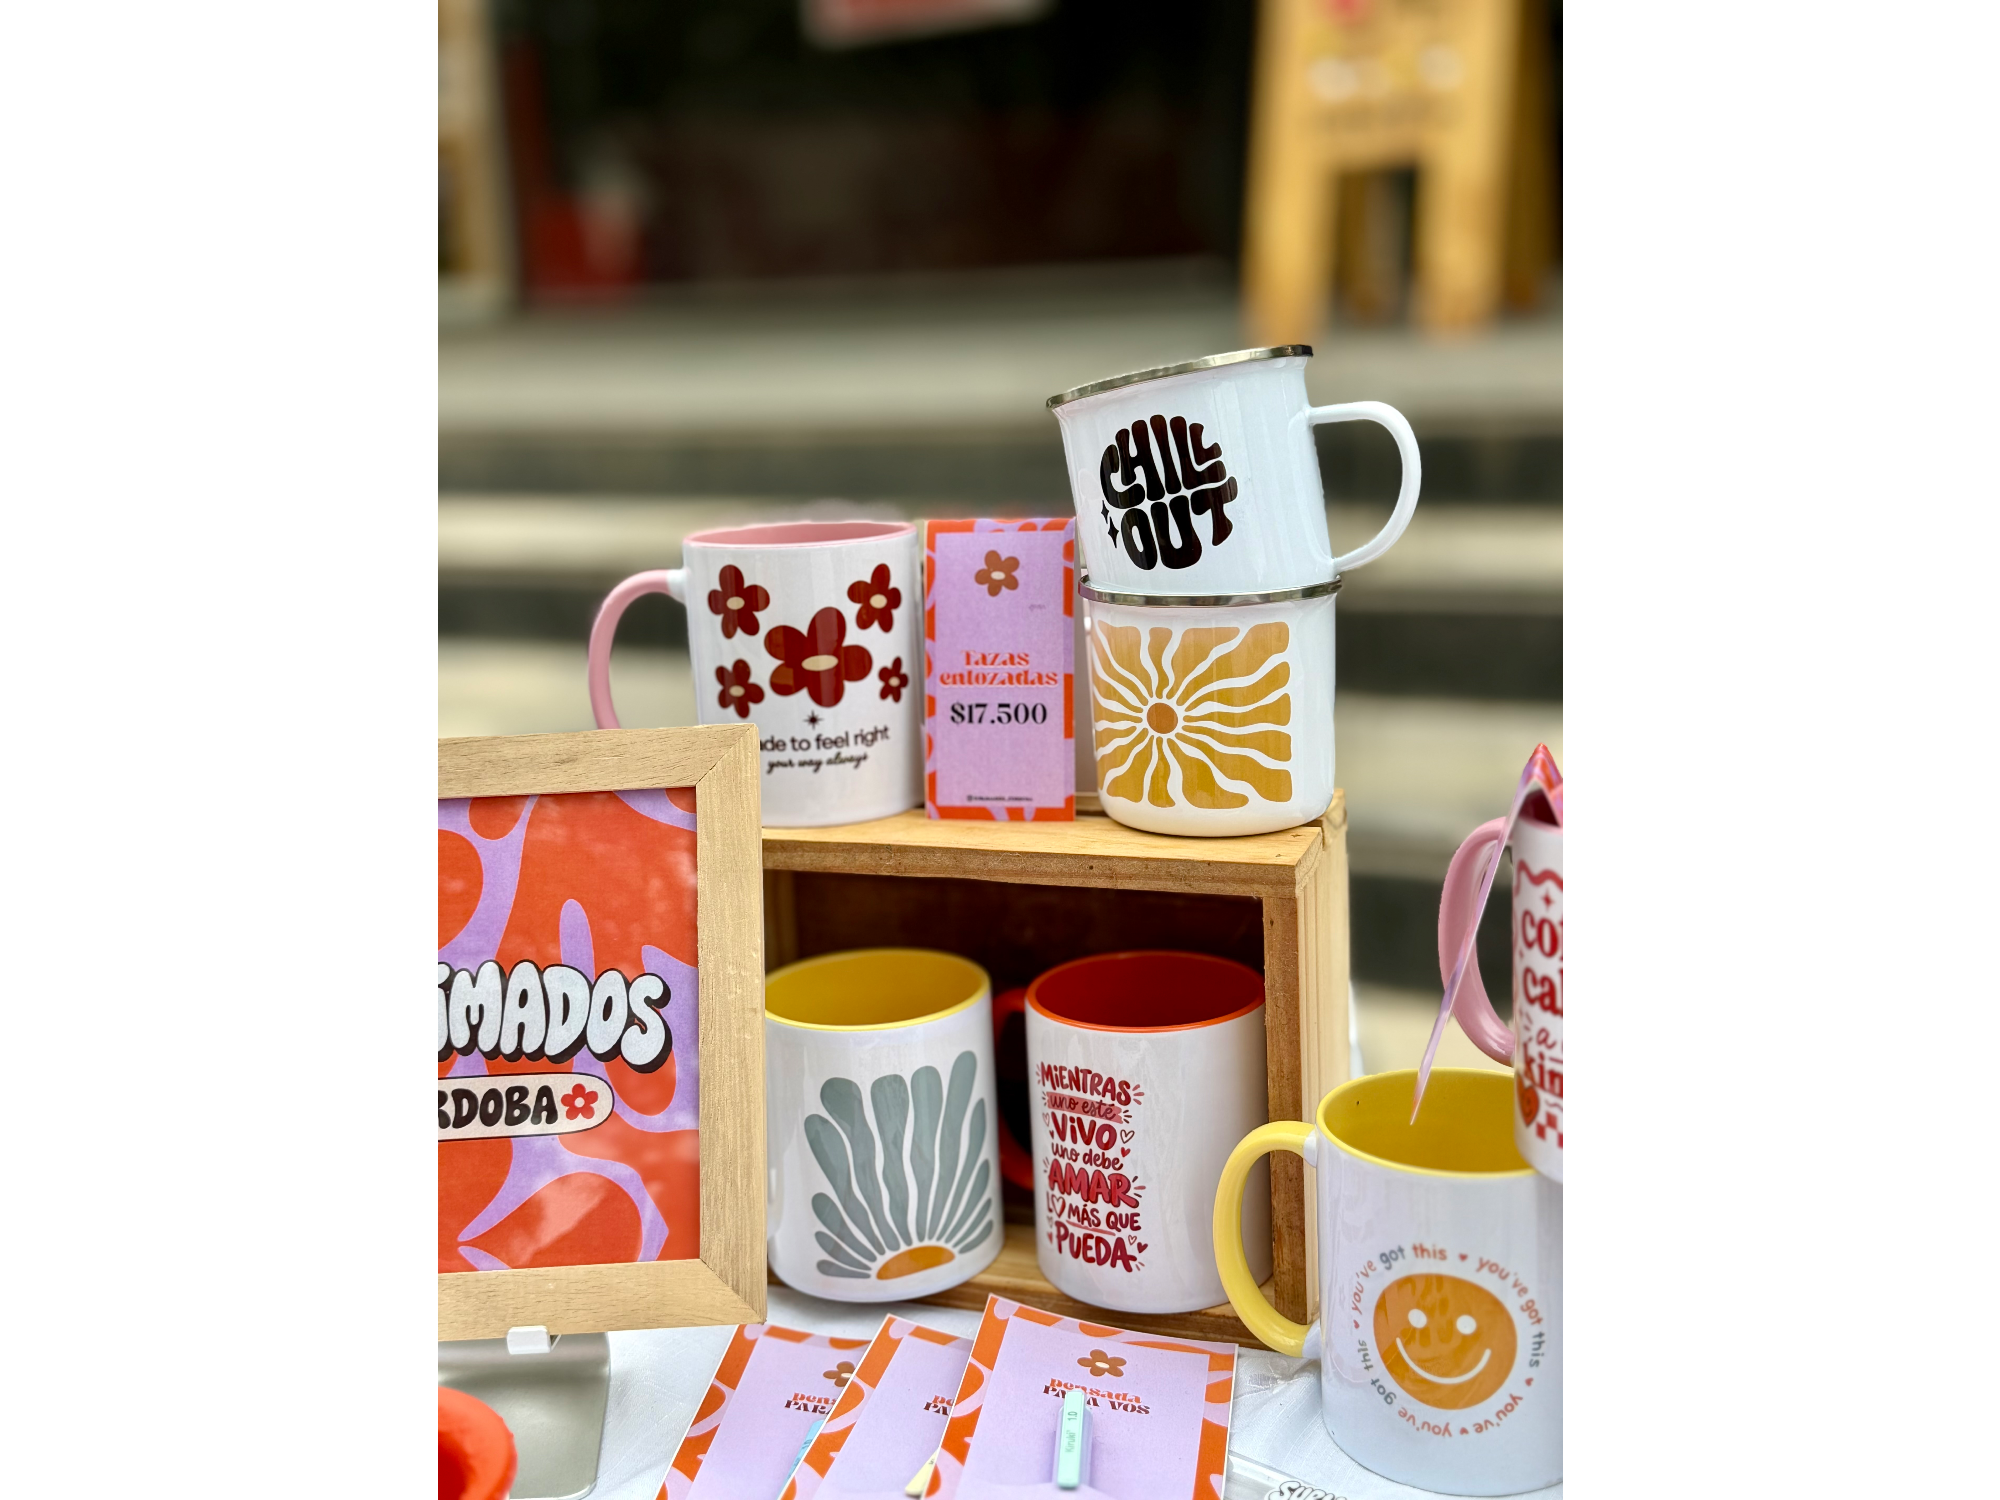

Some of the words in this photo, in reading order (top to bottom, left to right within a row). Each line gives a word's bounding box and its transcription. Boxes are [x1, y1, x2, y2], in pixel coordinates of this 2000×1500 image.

[1100, 414, 1227, 509] CHILL
[1120, 476, 1238, 570] OUT
[961, 651, 1030, 666] Tazas
[939, 670, 1058, 686] enlozadas
[950, 701, 1048, 725] $17.500
[790, 736, 811, 751] to
[815, 730, 850, 750] feel
[854, 725, 889, 747] right
[766, 759, 795, 774] your
[798, 758, 822, 773] way
[826, 751, 868, 769] always
[1050, 1093, 1079, 1112] uno
[1082, 1099, 1116, 1120] esté
[1051, 1142, 1079, 1162] uno
[1082, 1149, 1123, 1171] debe
[1048, 1158, 1139, 1209] AMAR
[1067, 1204, 1101, 1228] MÁS
[1106, 1211, 1142, 1232] QUE
[1055, 1221, 1138, 1273] PUEDA
[1351, 1259, 1377, 1315] you've
[1379, 1245, 1406, 1271] got
[1412, 1243, 1447, 1261] this
[1475, 1256, 1529, 1298] you've
[1520, 1298, 1544, 1326] got
[1358, 1339, 1374, 1371] this
[1529, 1331, 1546, 1368] this
[1043, 1385, 1100, 1408] PAA
[1109, 1400, 1150, 1414] VOS
[1370, 1378, 1397, 1405] got
[1398, 1407, 1452, 1437] you've
[1475, 1392, 1523, 1434] you've
